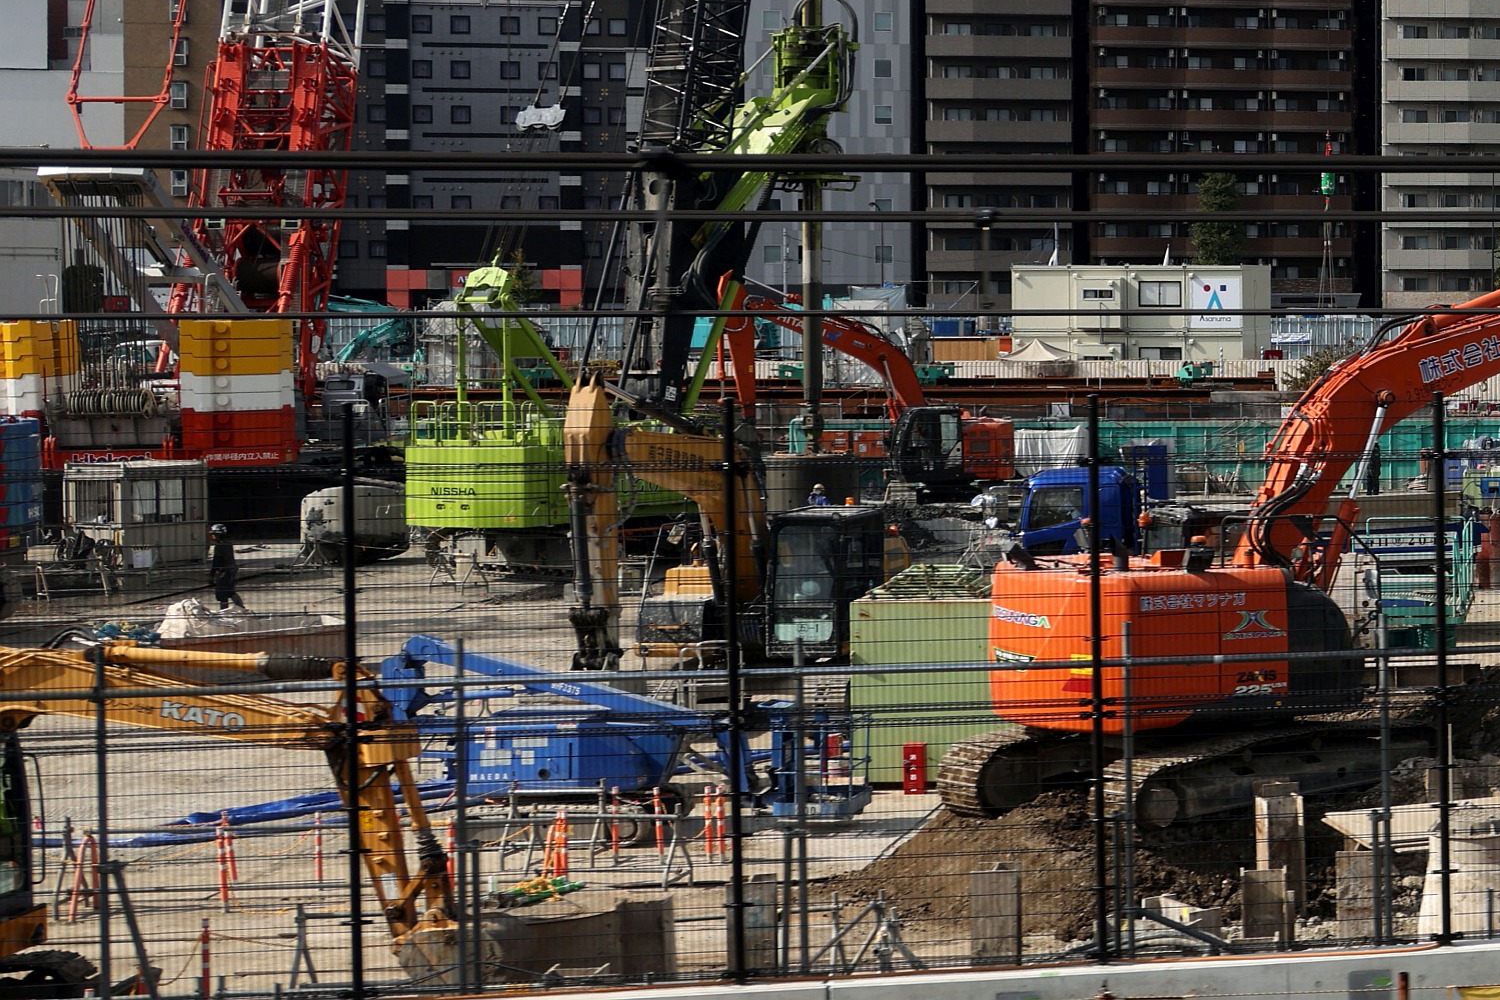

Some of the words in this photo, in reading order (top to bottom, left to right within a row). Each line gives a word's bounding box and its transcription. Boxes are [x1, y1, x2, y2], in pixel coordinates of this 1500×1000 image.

[776, 315, 826, 337] HITAI
[430, 486, 477, 496] NISSHA
[1234, 684, 1273, 696] 225
[160, 700, 246, 732] KATO
